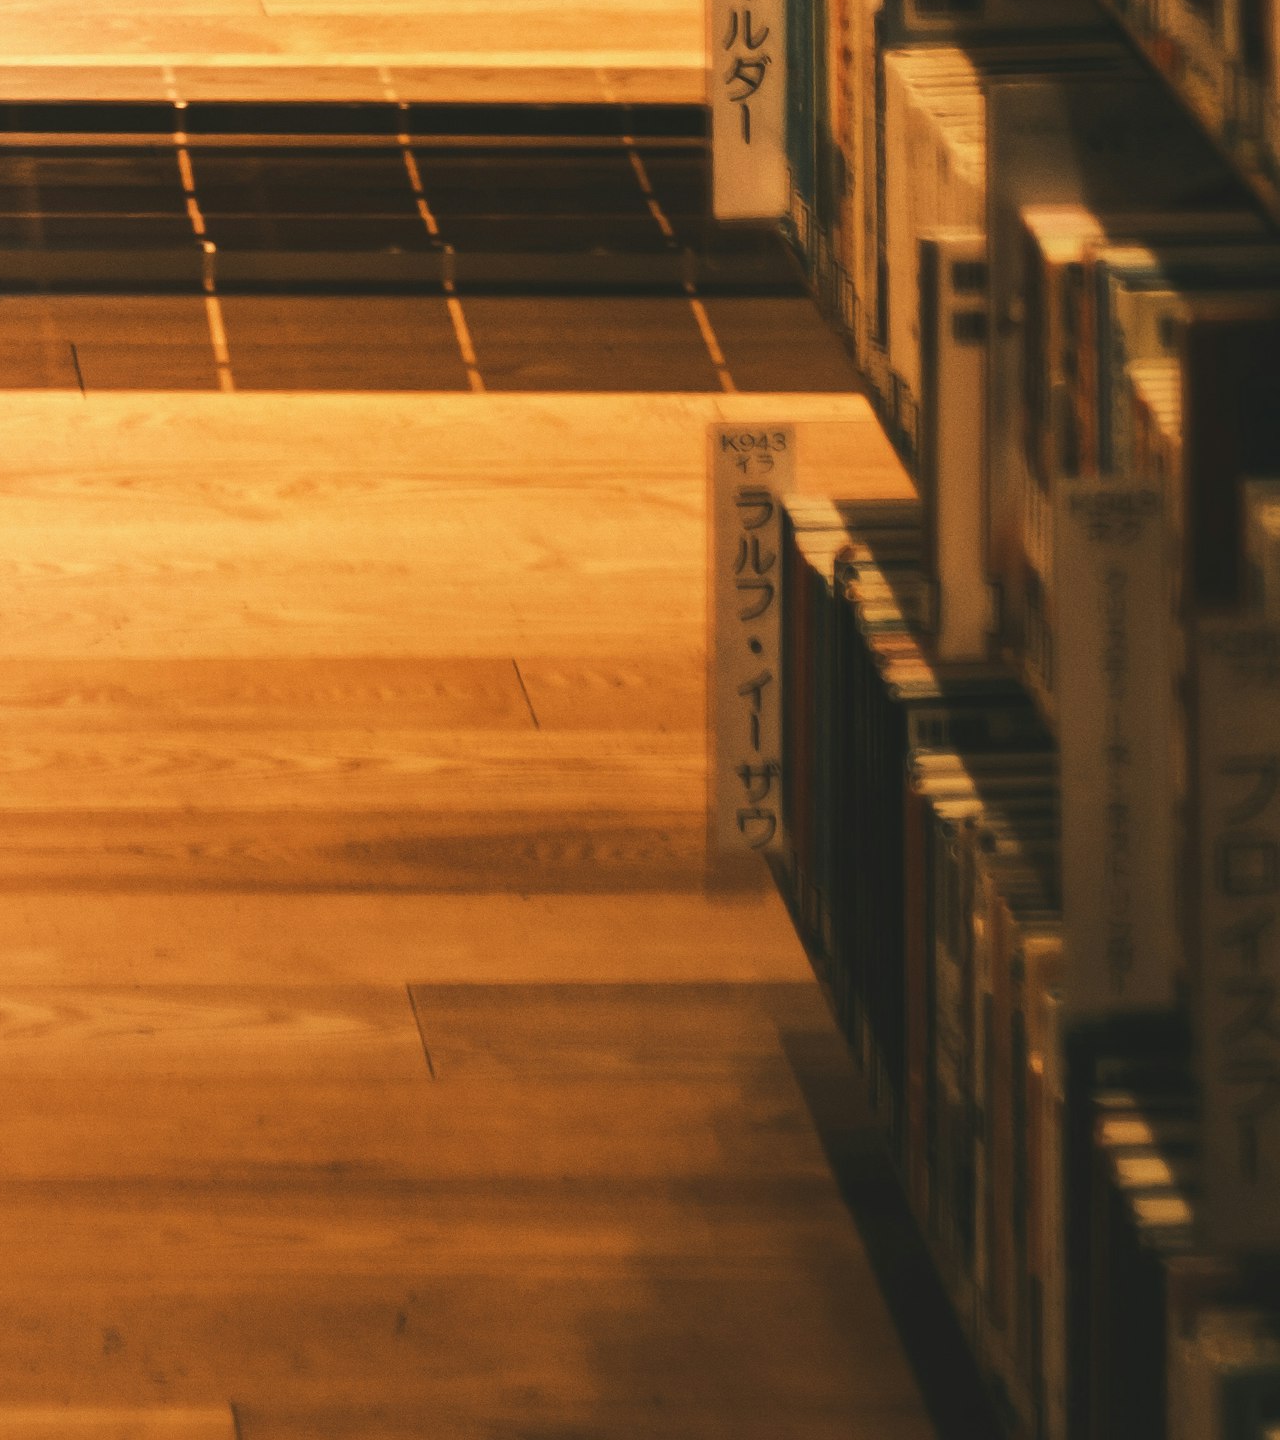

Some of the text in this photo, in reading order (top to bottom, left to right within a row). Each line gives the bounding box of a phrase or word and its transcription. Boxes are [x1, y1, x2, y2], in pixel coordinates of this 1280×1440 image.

[721, 432, 789, 453] K943
[734, 486, 782, 852] ラルフ・イーザウ
